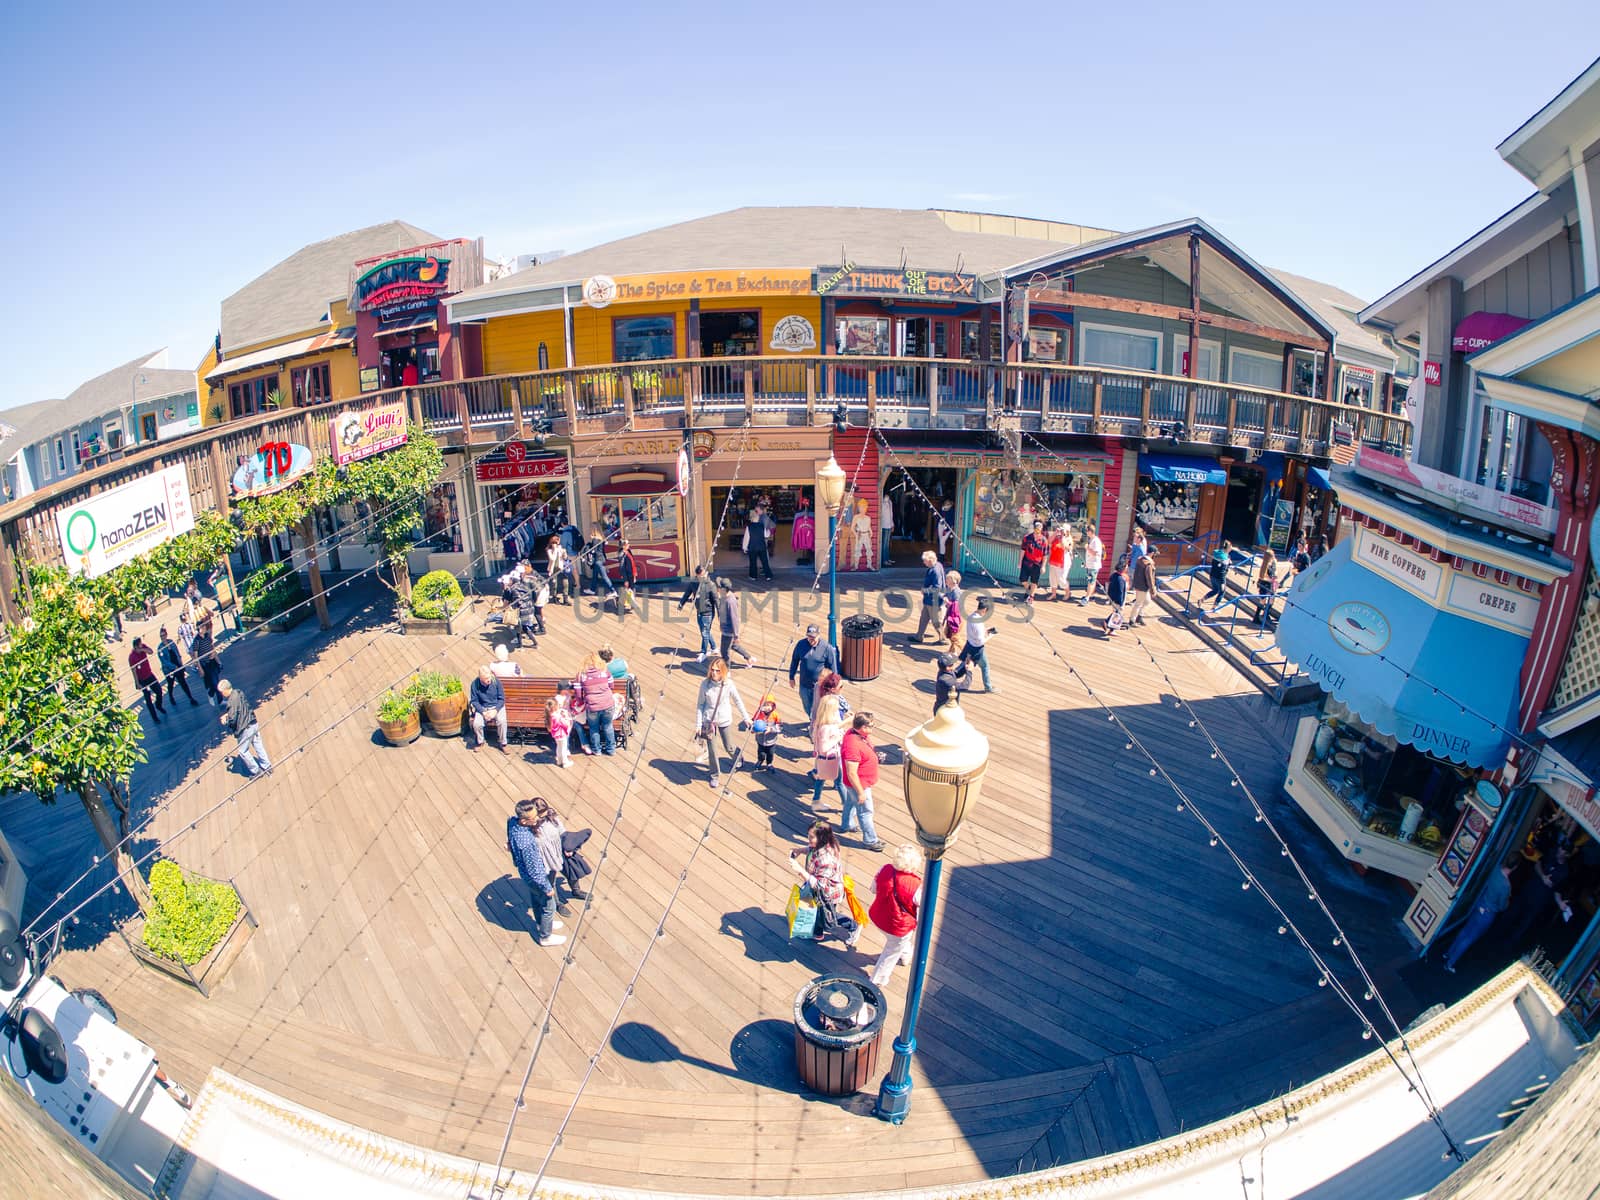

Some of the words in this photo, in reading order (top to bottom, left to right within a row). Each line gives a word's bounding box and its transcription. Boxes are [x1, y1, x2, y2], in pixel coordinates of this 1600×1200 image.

[848, 272, 904, 289] THINK
[905, 271, 927, 280] OUT
[909, 279, 923, 287] OF
[927, 273, 975, 296] BOX
[616, 282, 643, 299] The
[647, 281, 686, 300] Spice
[690, 278, 703, 294] &
[706, 277, 733, 293] Tea
[736, 276, 810, 295] Exchange
[906, 286, 927, 295] THE
[1425, 364, 1440, 384] illy
[364, 409, 403, 437] Luigi's
[508, 445, 523, 461] SF
[623, 440, 681, 456] CABLE
[488, 465, 513, 477] CITY
[517, 463, 547, 475] WEAR
[100, 502, 167, 549] hanaZEN
[1391, 553, 1427, 581] COFFEES
[1480, 592, 1517, 614] CREPES
[1305, 653, 1345, 690] LUNCH
[1412, 723, 1472, 756] DINNER
